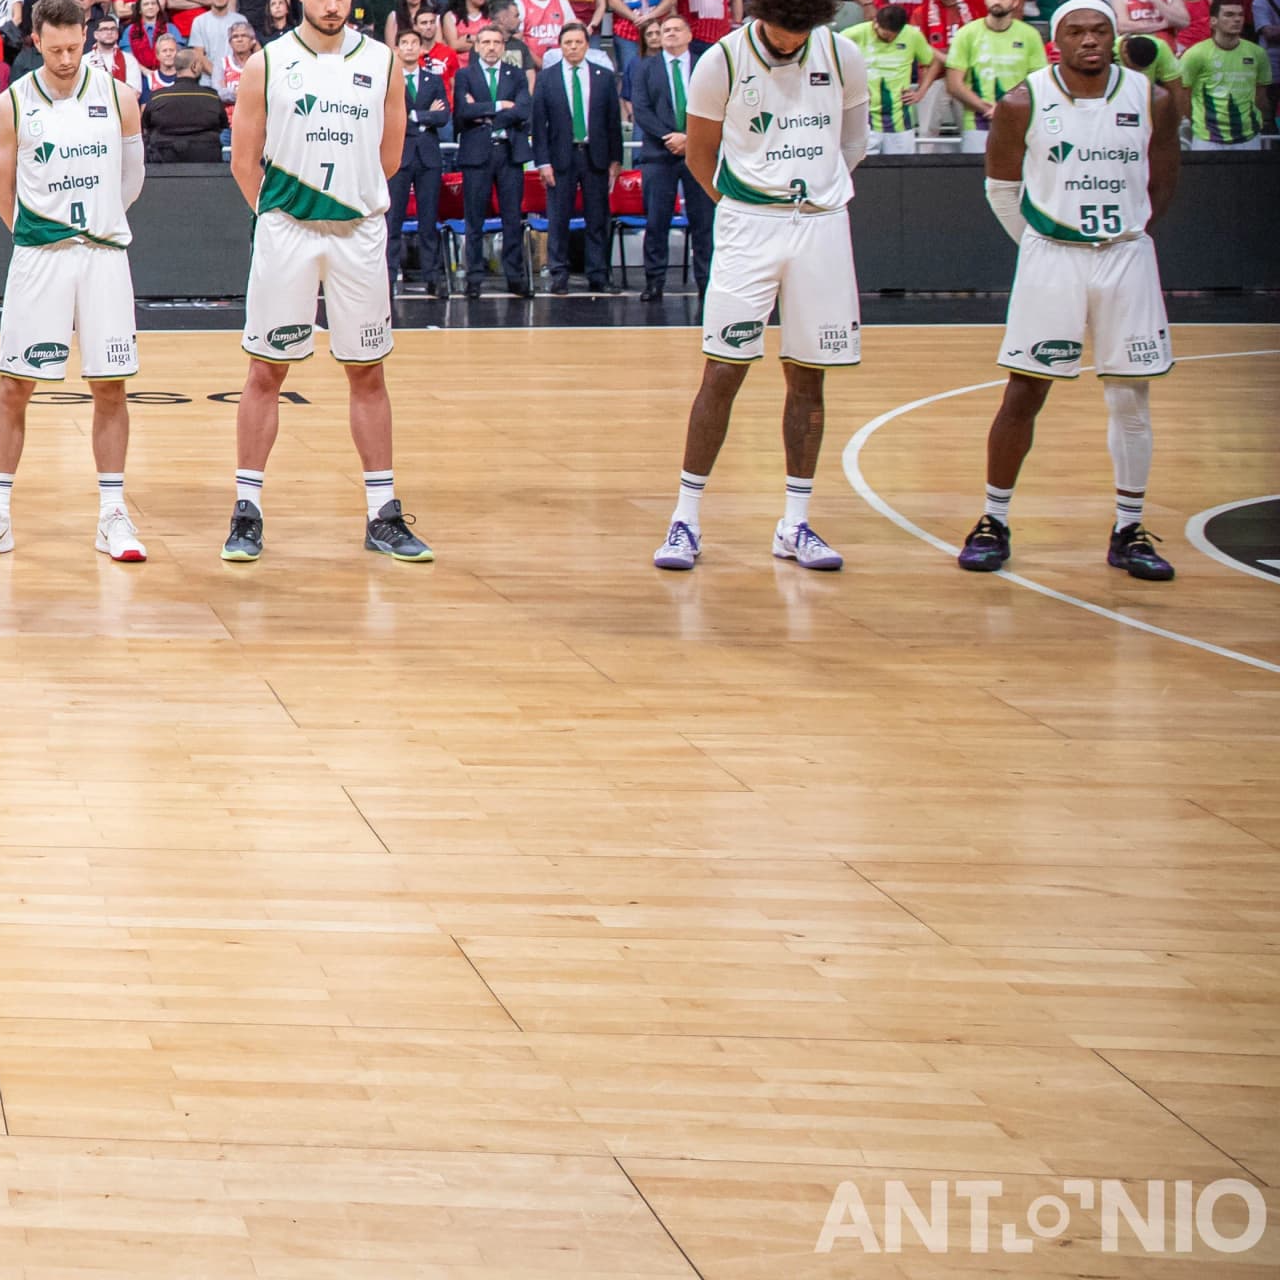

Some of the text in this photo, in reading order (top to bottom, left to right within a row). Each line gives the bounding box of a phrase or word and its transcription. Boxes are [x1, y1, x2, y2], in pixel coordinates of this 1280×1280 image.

[320, 100, 369, 120] Unicaja
[777, 113, 831, 130] Unicaja
[59, 141, 107, 158] Unicaja
[1078, 147, 1139, 164] Unicaja
[320, 163, 334, 190] 7
[71, 202, 87, 228] 4
[1080, 205, 1121, 234] 55
